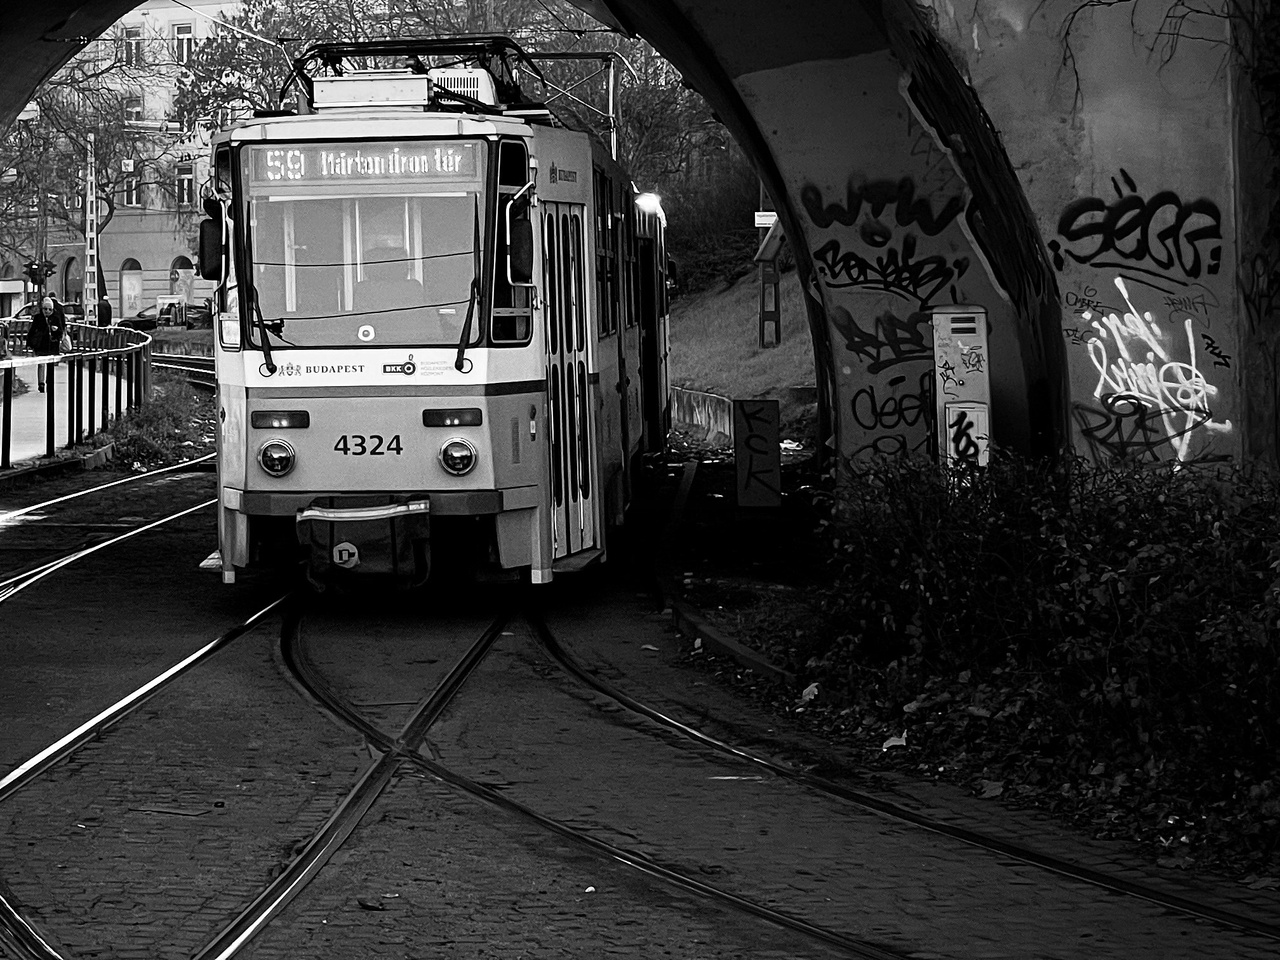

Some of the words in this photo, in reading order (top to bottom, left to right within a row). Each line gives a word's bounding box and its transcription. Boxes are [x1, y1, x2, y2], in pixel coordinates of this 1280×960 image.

[266, 150, 304, 180] 59
[305, 364, 365, 375] BUDAPEST
[333, 434, 404, 456] 4324
